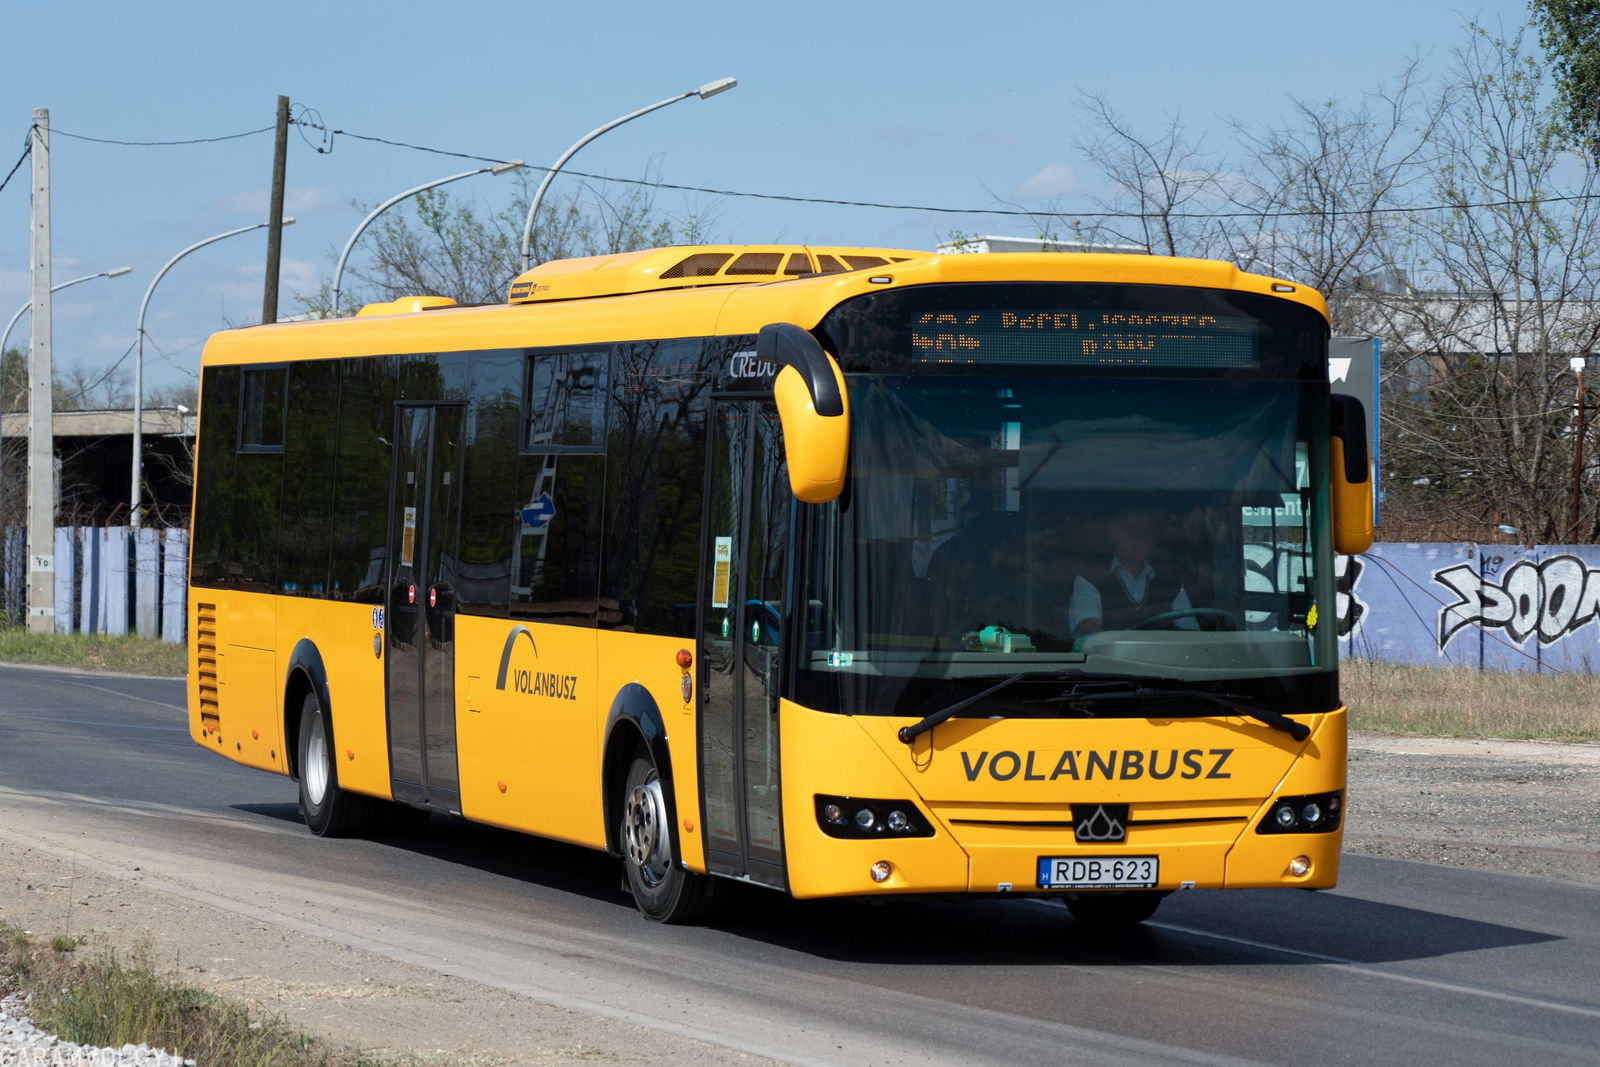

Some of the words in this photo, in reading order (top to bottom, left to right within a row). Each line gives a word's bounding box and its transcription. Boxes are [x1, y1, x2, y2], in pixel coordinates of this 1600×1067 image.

[514, 668, 577, 700] VOLÁNBUSZ
[960, 749, 1234, 782] VOLÁNBUSZ
[1056, 860, 1152, 881] RDB-623
